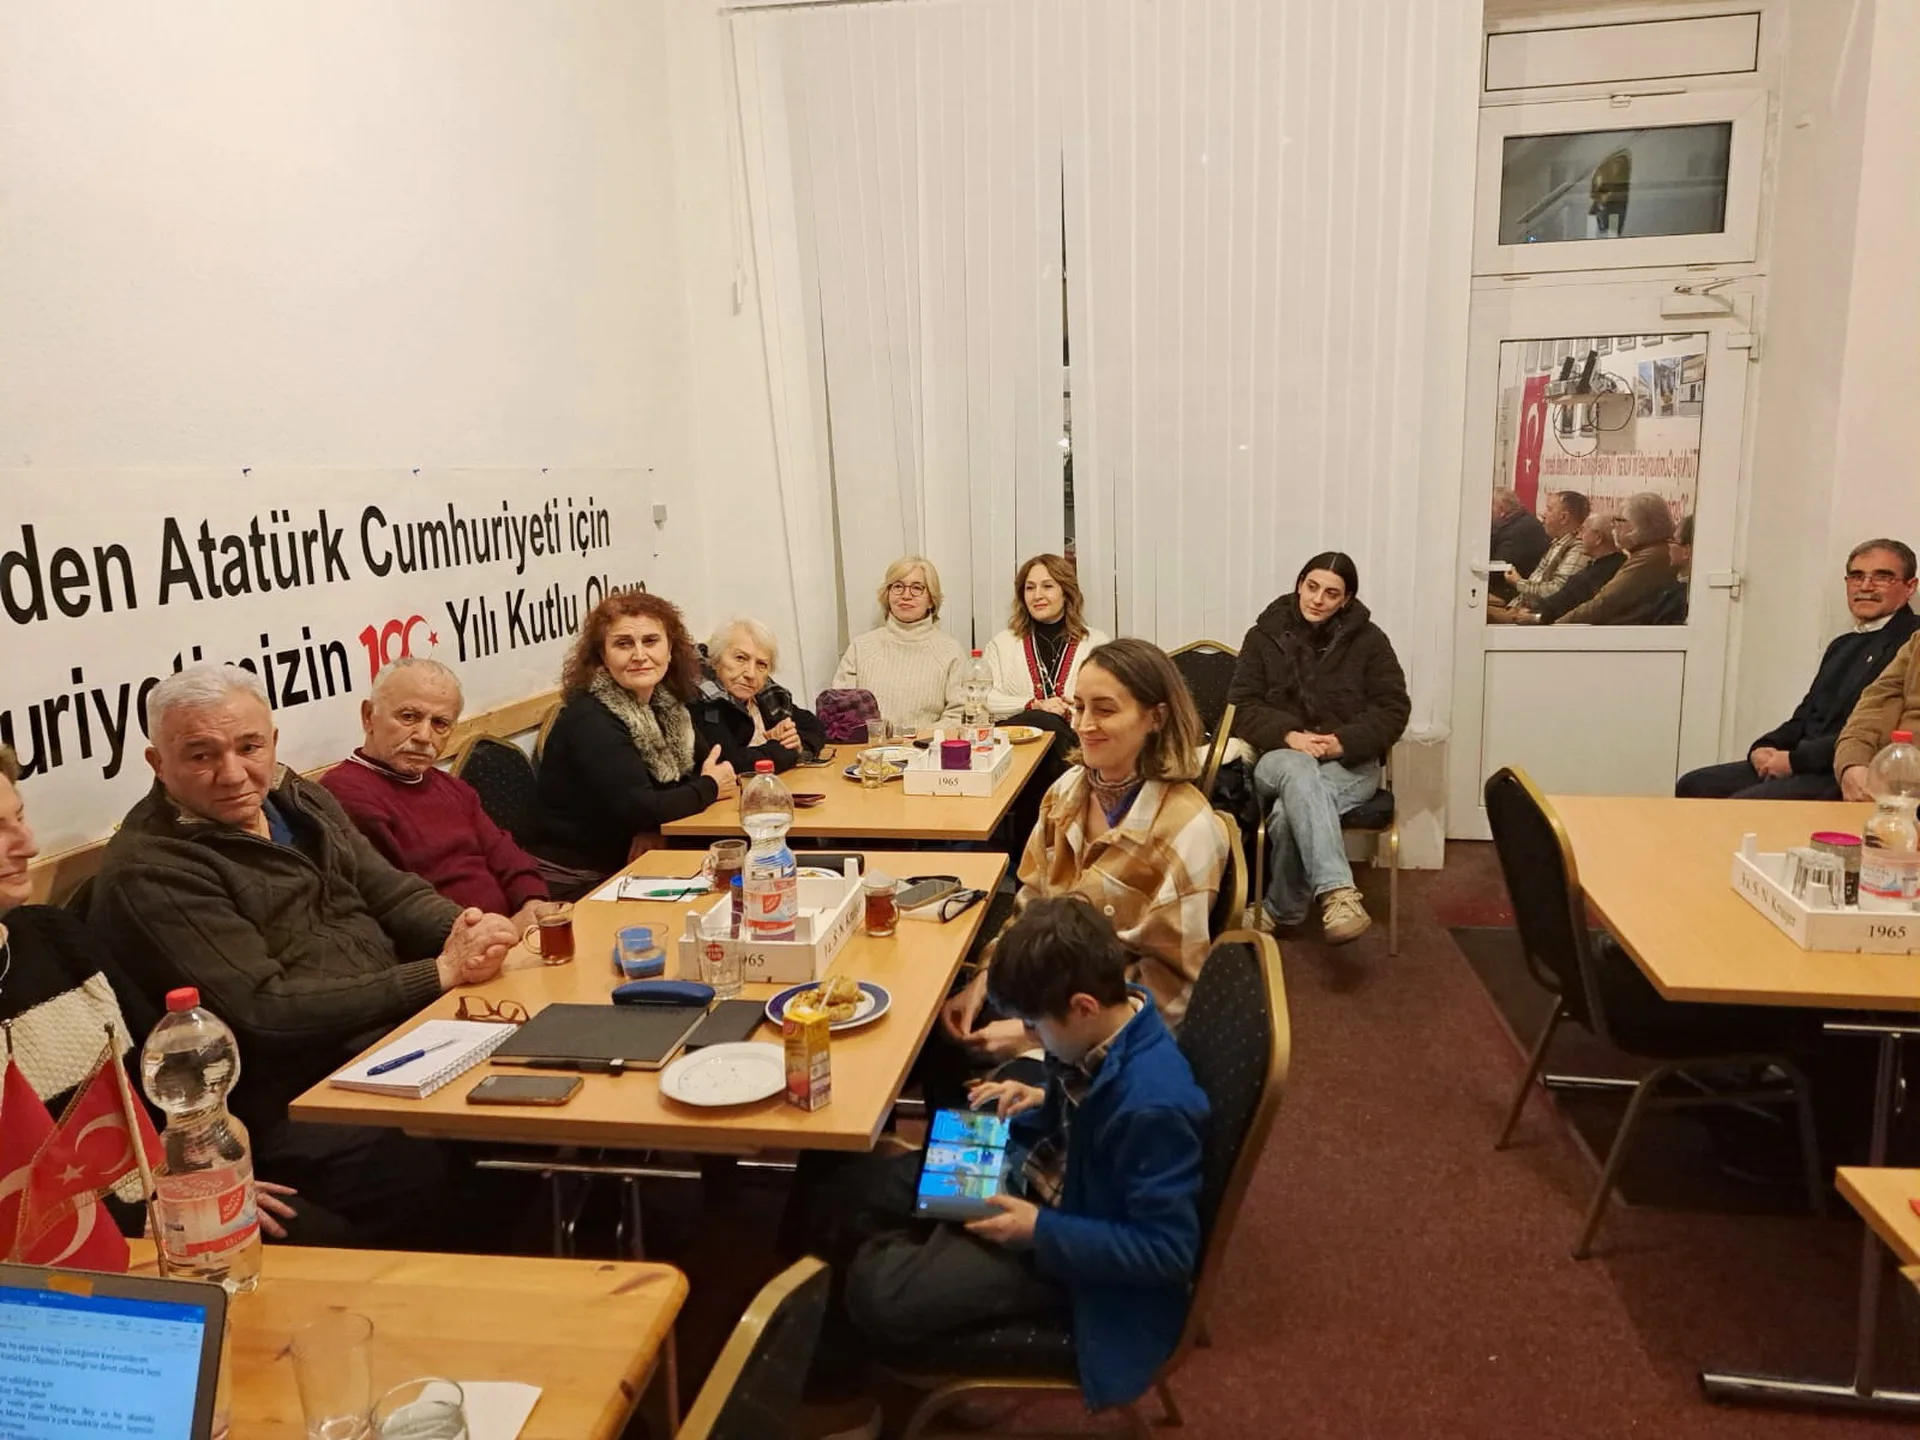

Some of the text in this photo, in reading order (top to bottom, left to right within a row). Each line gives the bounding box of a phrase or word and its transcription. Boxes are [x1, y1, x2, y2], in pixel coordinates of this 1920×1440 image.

[0, 496, 610, 624] den Atatürk Cumhuriyeti için
[0, 626, 352, 779] uriyizin
[446, 596, 498, 662] Yılı
[506, 583, 579, 649] Kutlu
[938, 776, 959, 787] 1965
[1868, 925, 1906, 939] 1965
